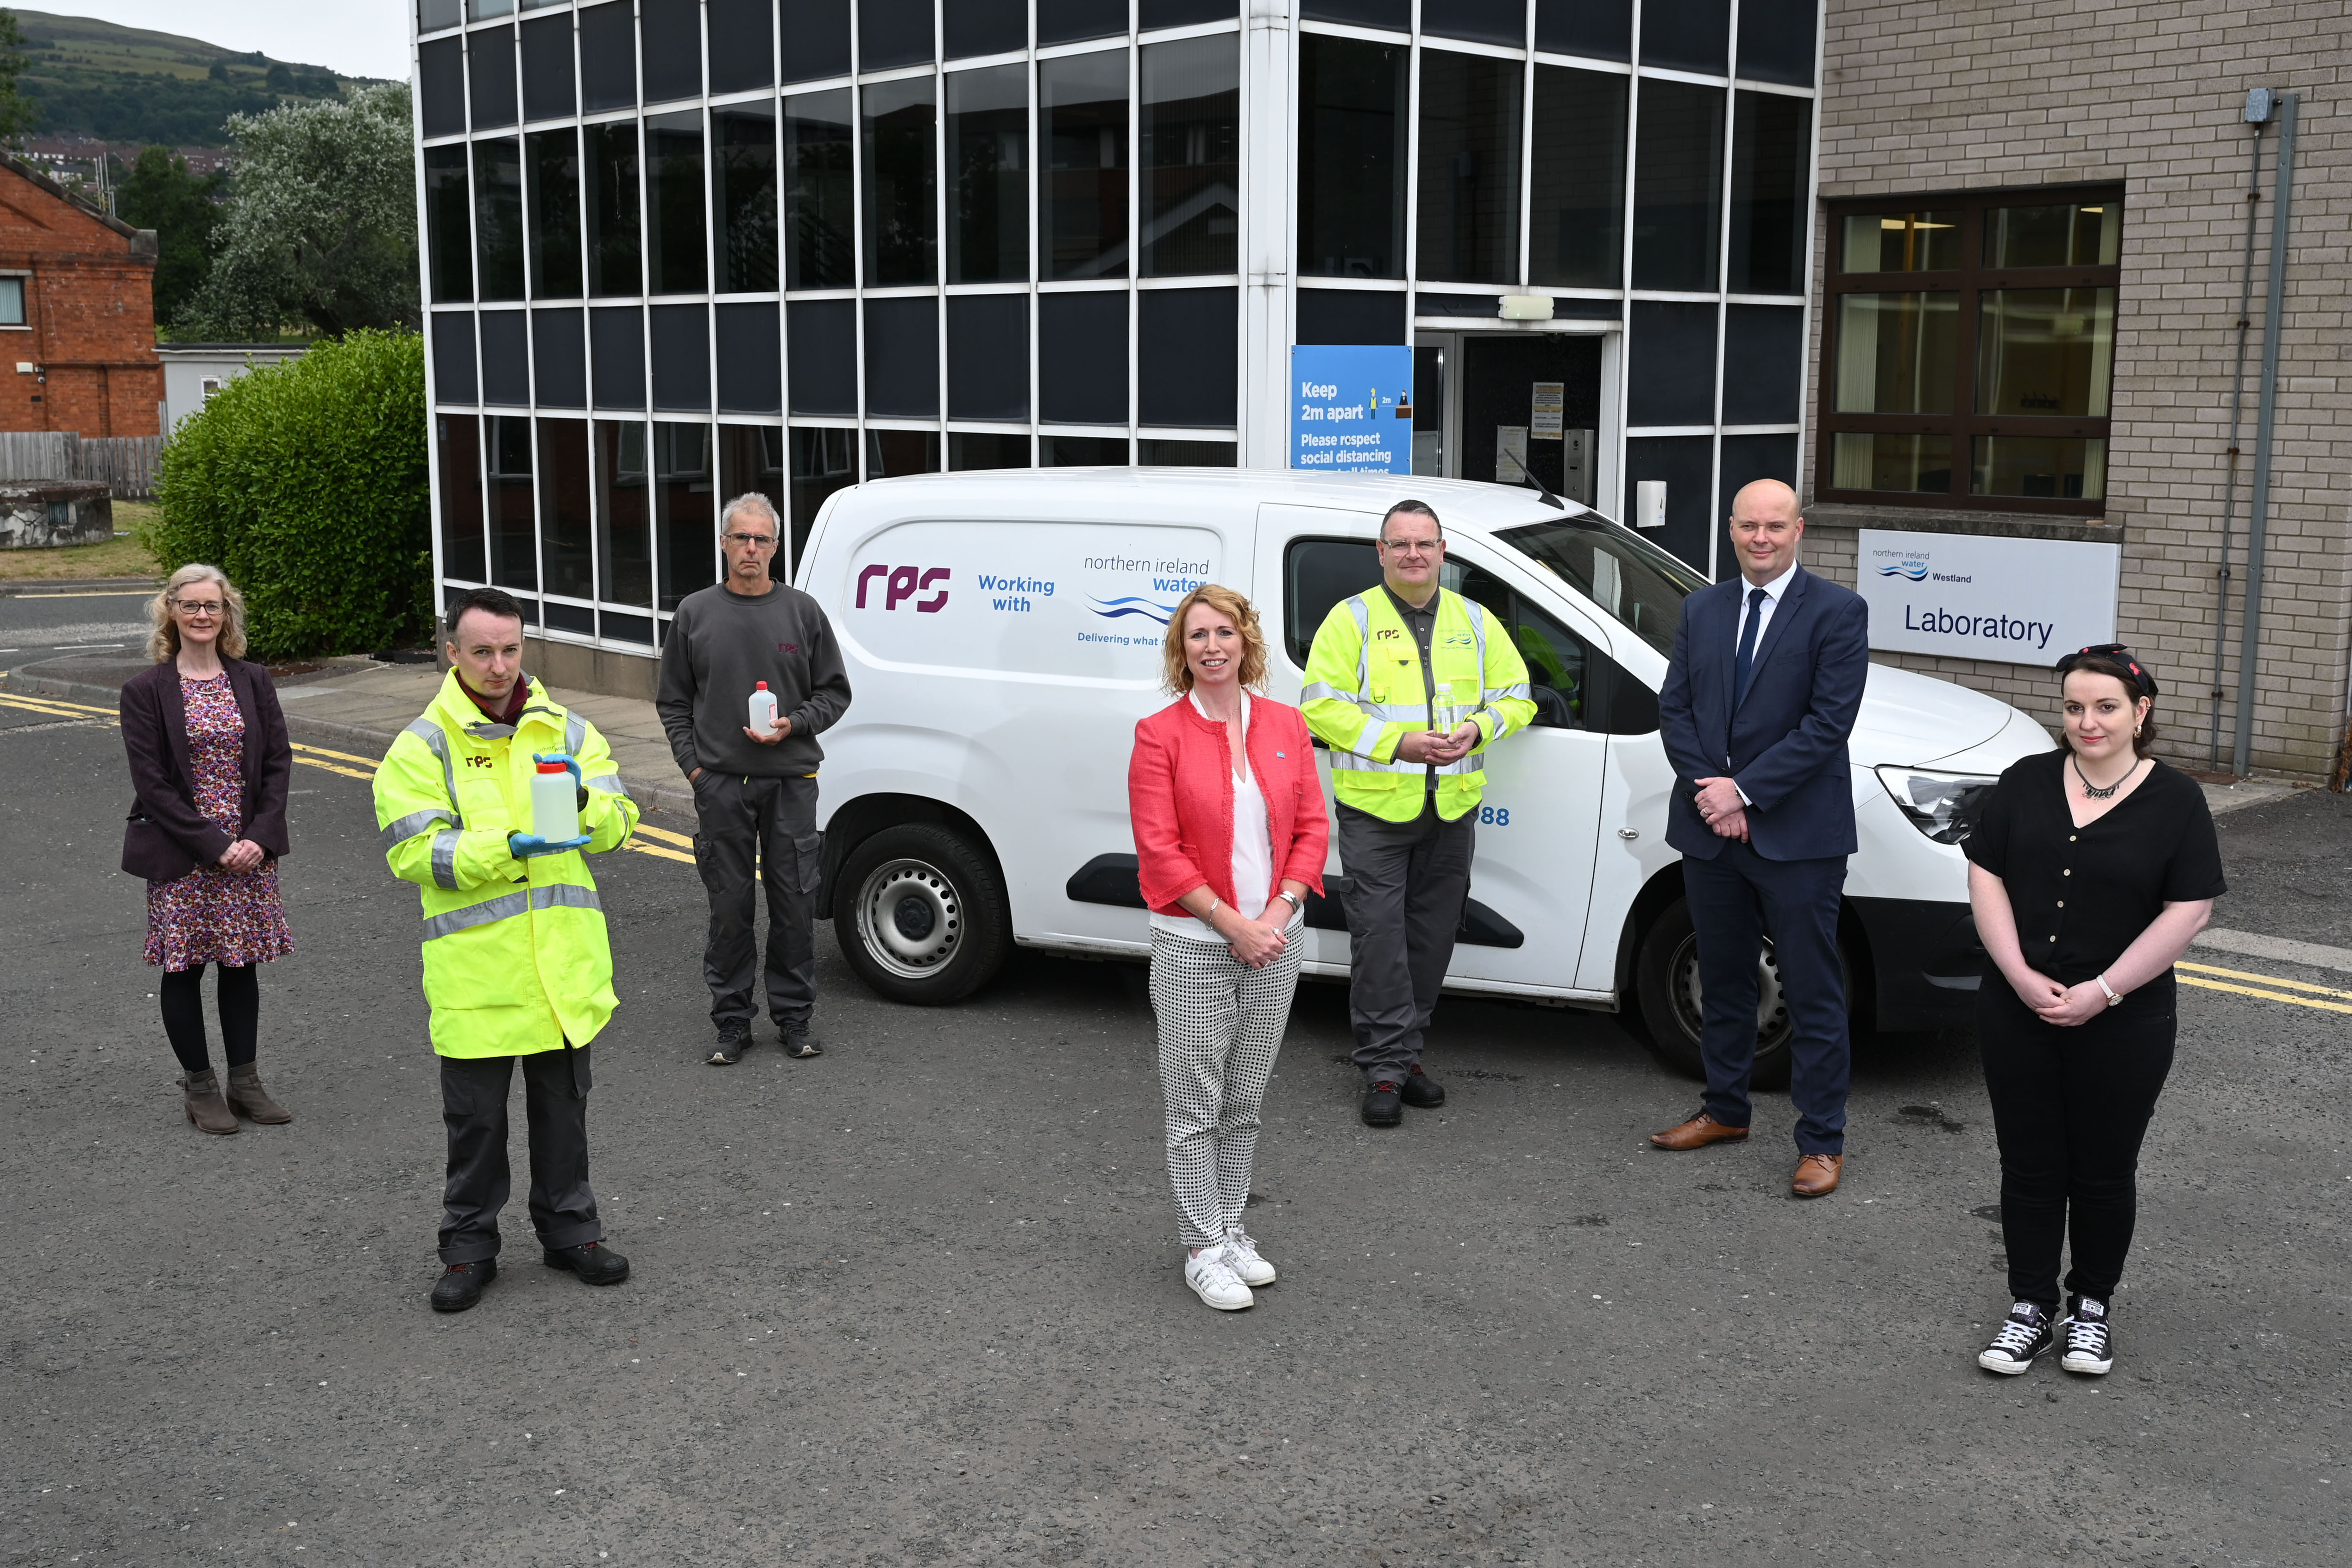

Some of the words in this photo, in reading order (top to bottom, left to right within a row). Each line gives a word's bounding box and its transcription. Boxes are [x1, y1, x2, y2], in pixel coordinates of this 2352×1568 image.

[1302, 382, 1338, 401] Keep
[1302, 404, 1324, 421] 2m
[1327, 404, 1364, 423] apart
[1301, 434, 1338, 447] Please
[1340, 432, 1381, 447] respect
[1301, 450, 1333, 464] social
[1336, 449, 1391, 463] distancing
[1873, 549, 1903, 558] northern
[1905, 550, 1930, 560] ireland
[1084, 555, 1151, 572] northern
[1155, 558, 1209, 574] ireland
[978, 575, 1055, 596] Working
[1933, 573, 1972, 583] Westland
[856, 564, 950, 613] rps
[993, 596, 1031, 612] with
[1905, 605, 2053, 649] Laboratory
[1078, 632, 1130, 645] Delivering
[1133, 636, 1158, 646] what
[1478, 806, 1509, 826] 88
